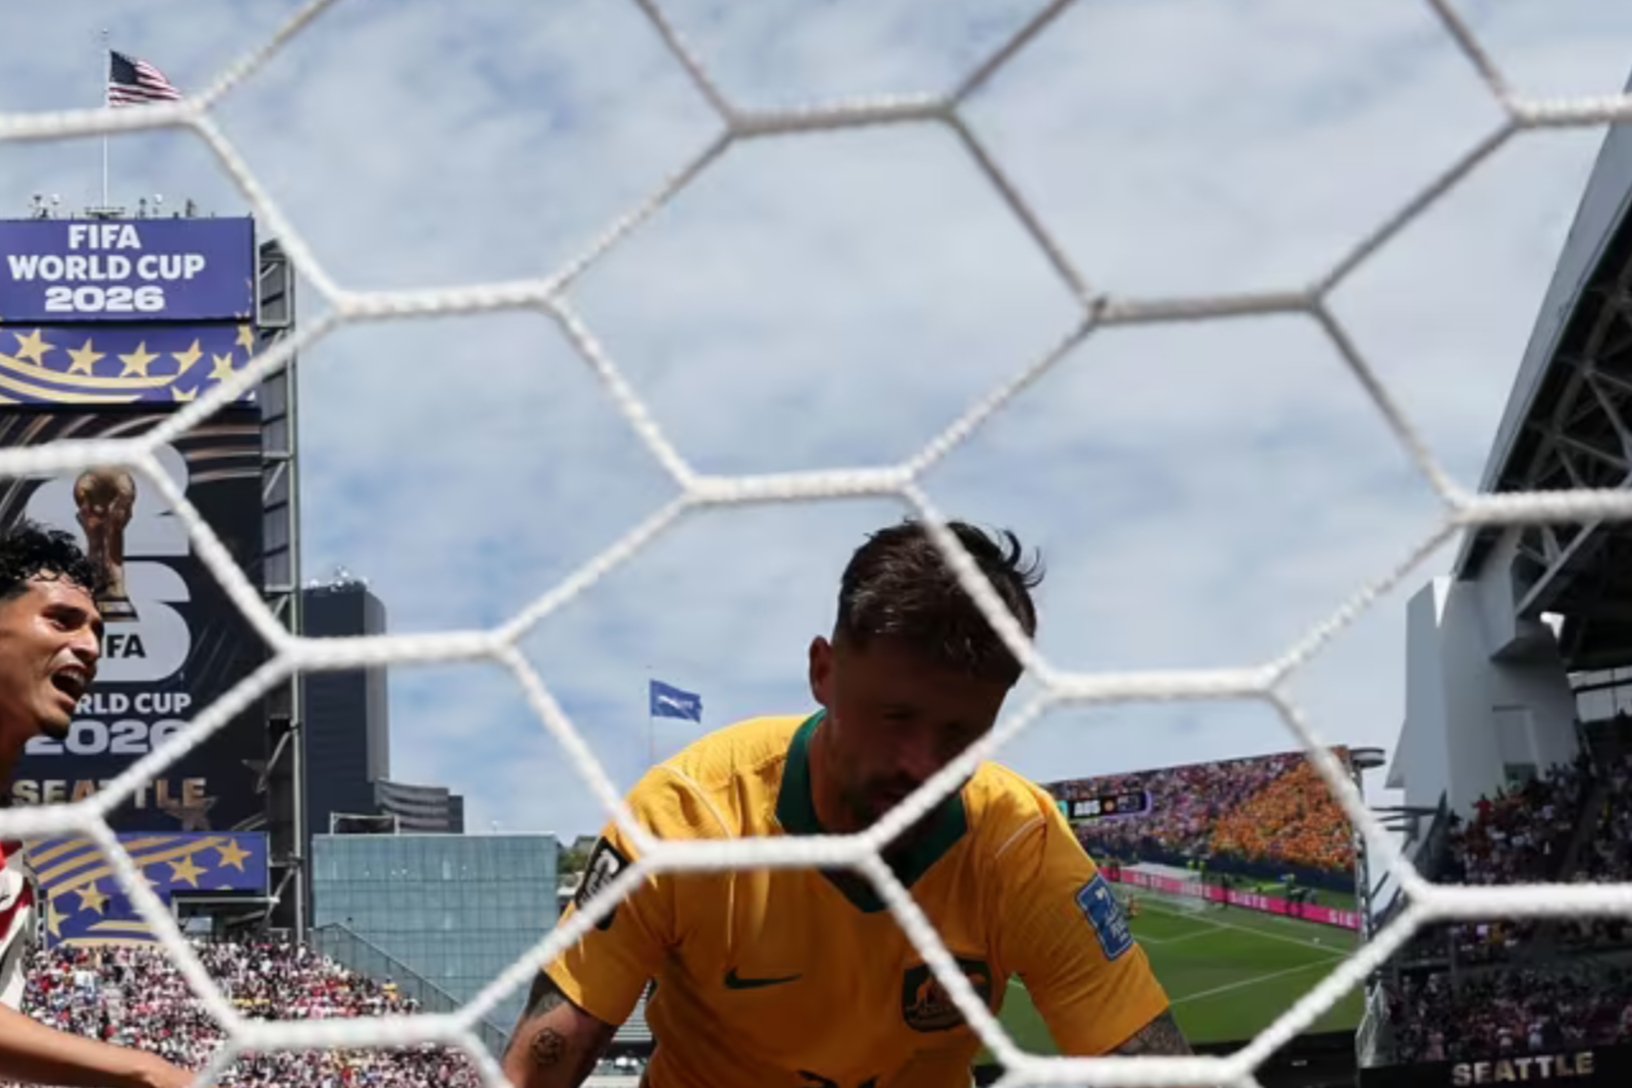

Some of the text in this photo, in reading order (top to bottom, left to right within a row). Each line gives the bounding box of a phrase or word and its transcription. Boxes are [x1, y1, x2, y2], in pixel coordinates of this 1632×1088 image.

[68, 224, 142, 250] FIFA
[7, 254, 206, 281] WORLD CUP
[44, 285, 166, 313] 2026
[102, 633, 147, 659] FA
[74, 692, 131, 715] RLD
[134, 692, 192, 715] CUP
[1452, 1051, 1595, 1087] SEATTLE
